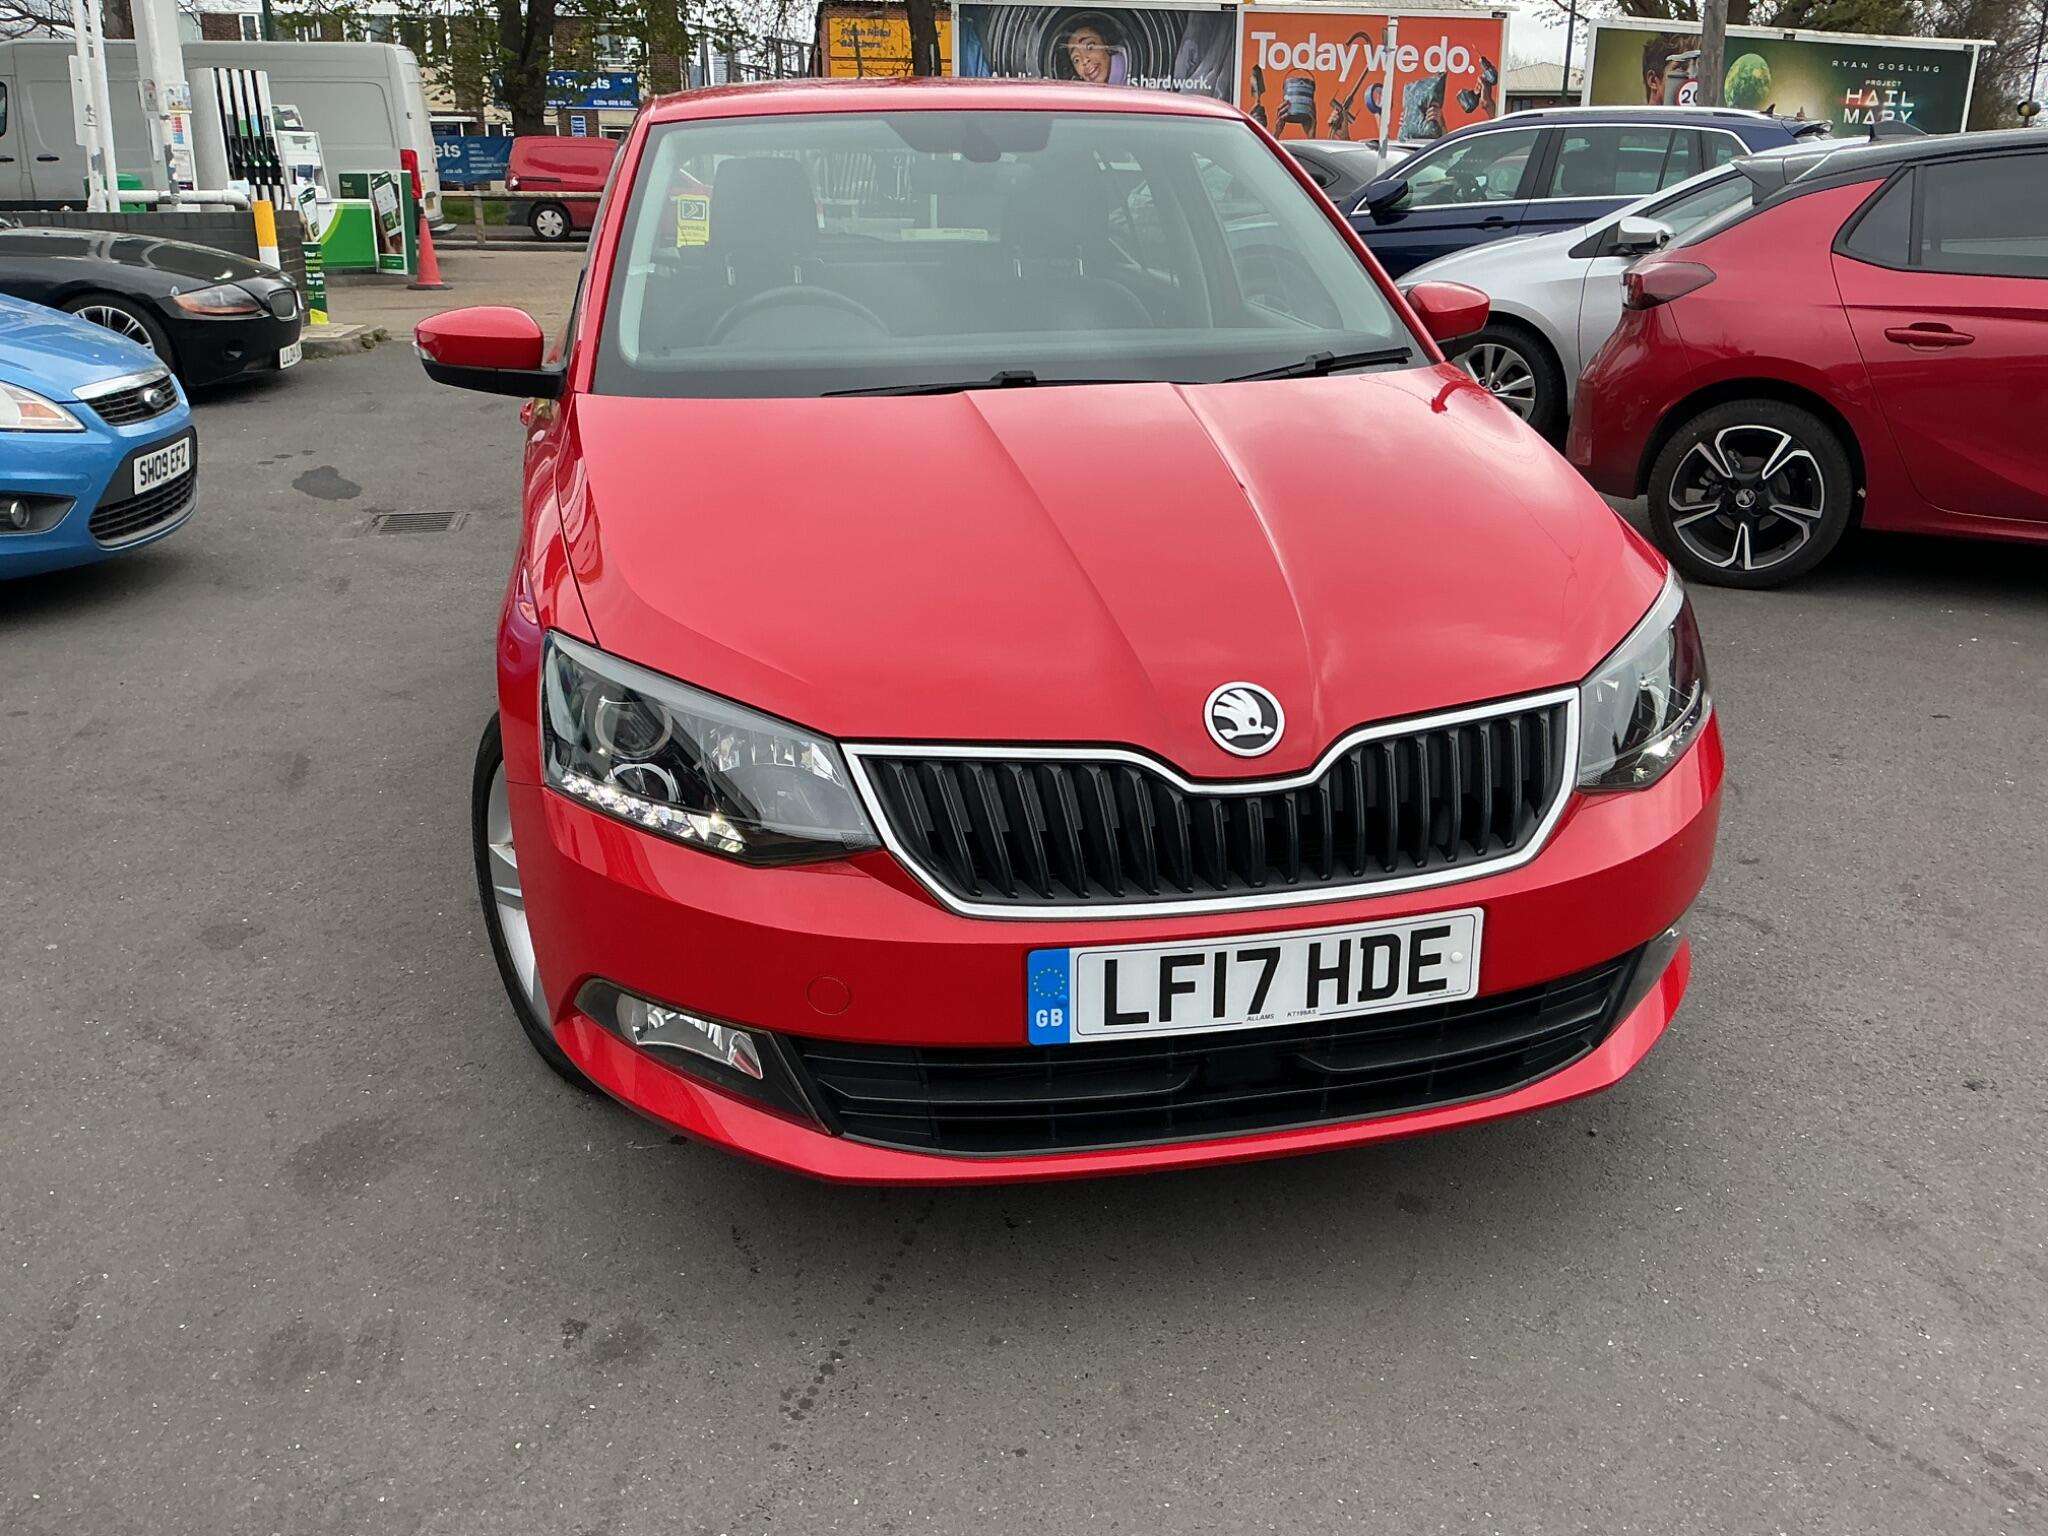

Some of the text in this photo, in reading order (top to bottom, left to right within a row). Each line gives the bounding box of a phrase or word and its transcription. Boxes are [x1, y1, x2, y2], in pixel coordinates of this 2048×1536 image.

[1250, 31, 1475, 82] Today we do.
[1832, 60, 1940, 73] RYAN GOSLING
[1127, 74, 1211, 90] is hard work.
[1865, 79, 1902, 87] PROJECT
[1846, 88, 1915, 107] HAIL
[1843, 108, 1913, 124] MARY
[140, 452, 168, 486] SH09
[1104, 925, 1451, 1027] LF17 HDE
[1035, 1008, 1063, 1028] GB
